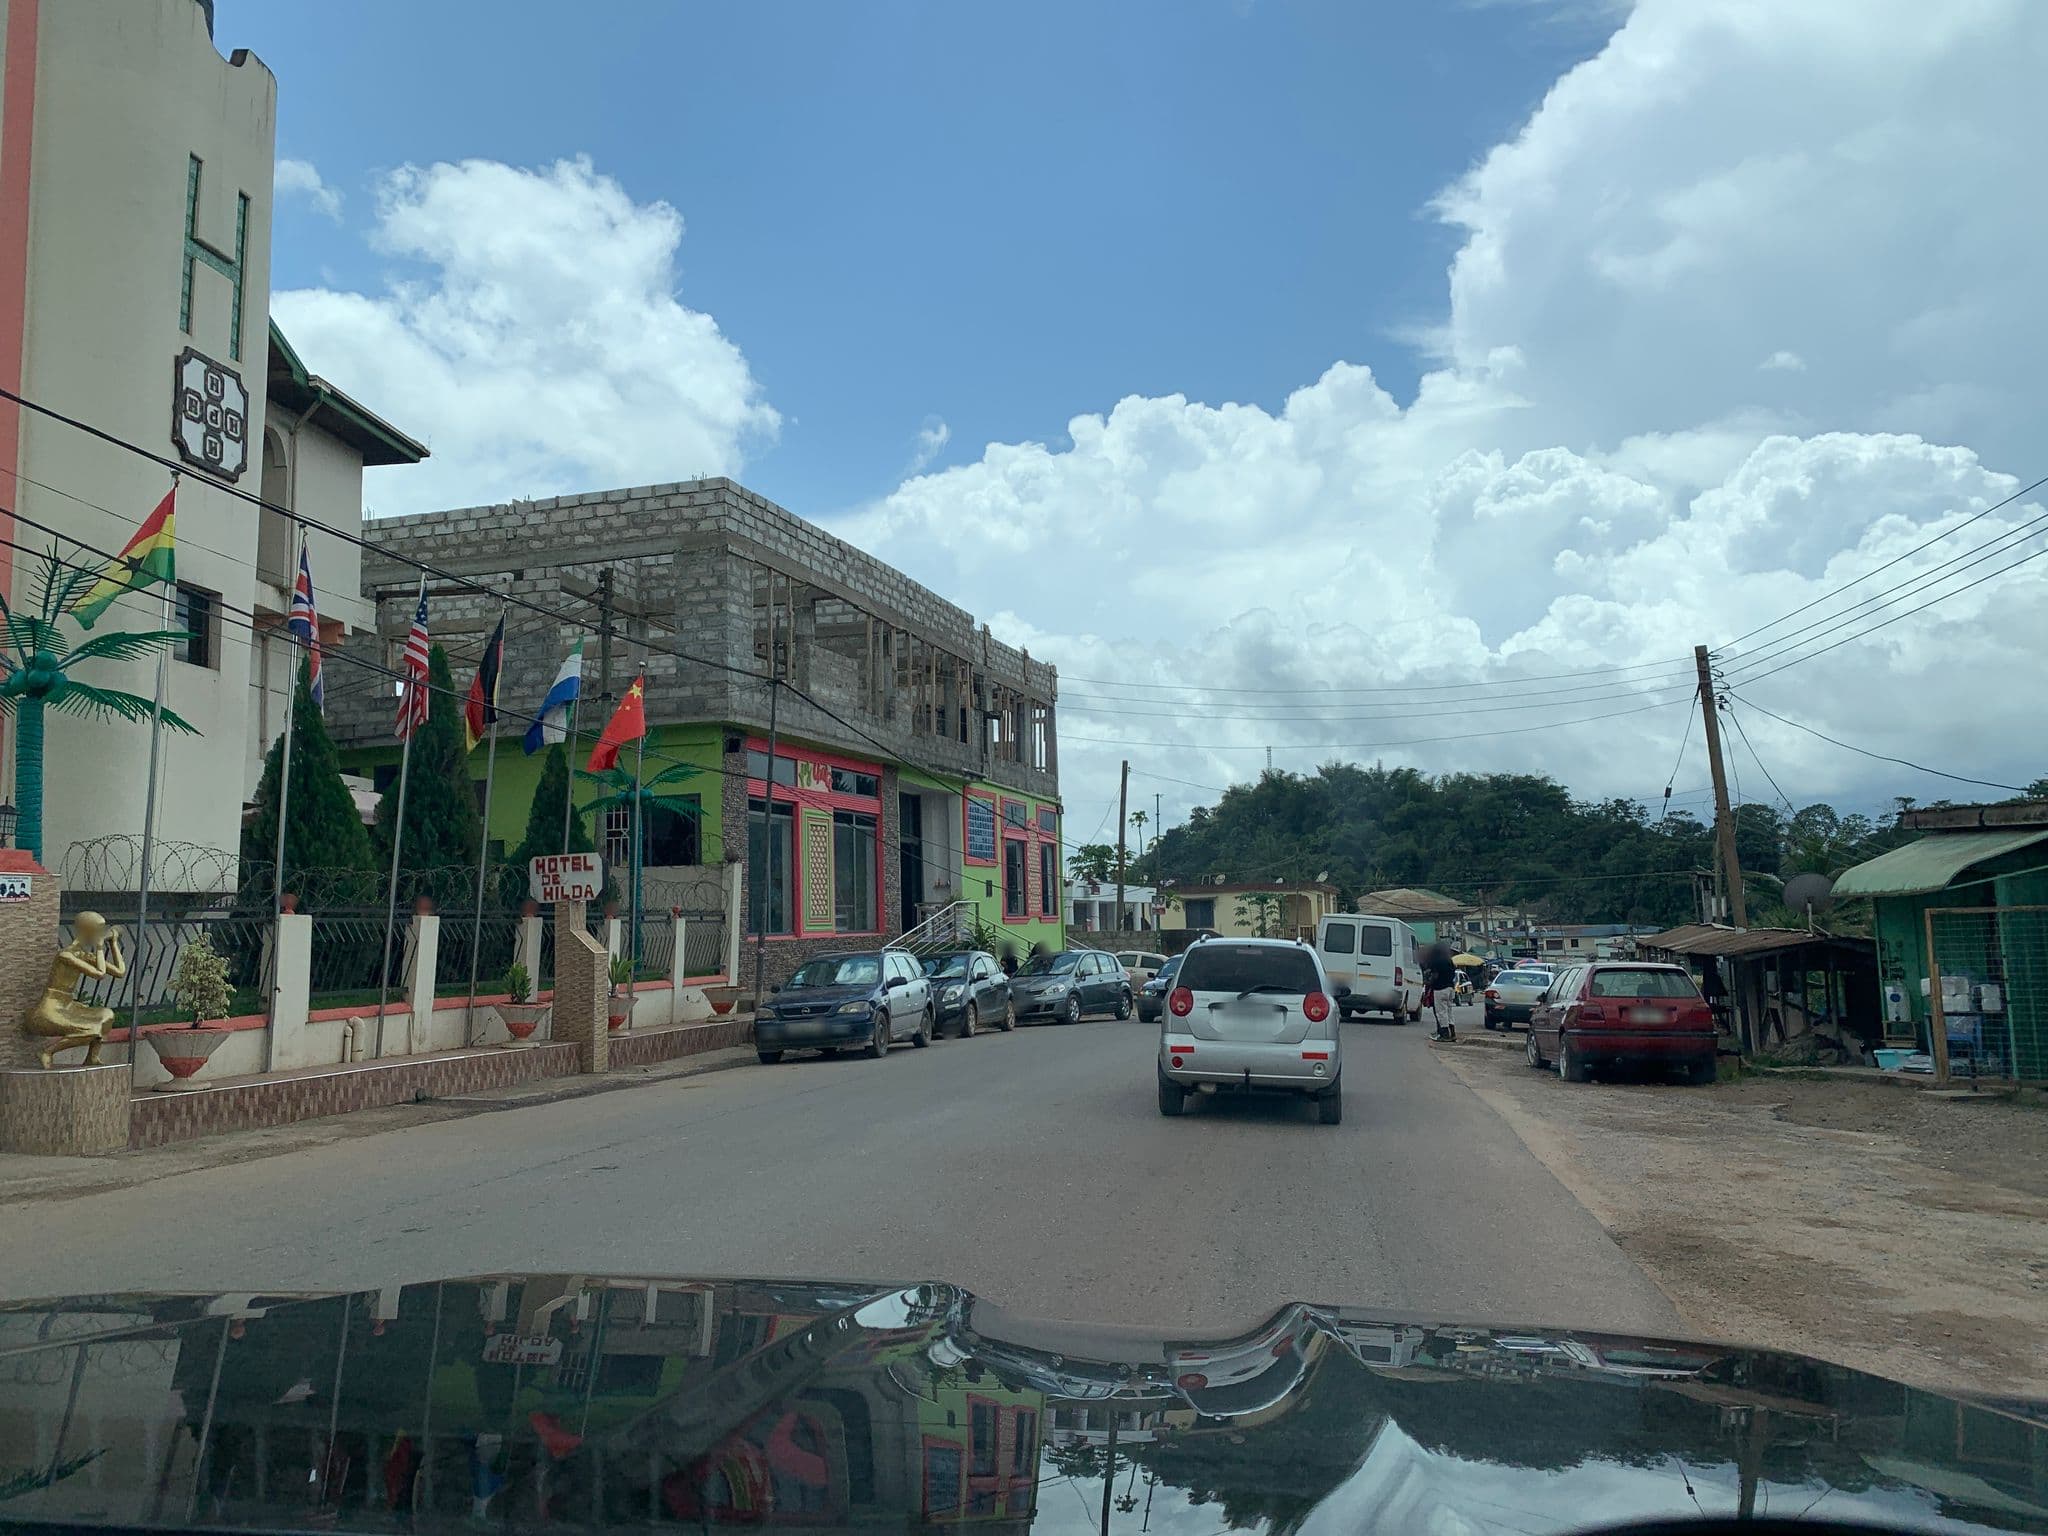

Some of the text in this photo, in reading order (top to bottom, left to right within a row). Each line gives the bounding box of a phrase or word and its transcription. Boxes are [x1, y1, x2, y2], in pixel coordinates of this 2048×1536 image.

[535, 856, 594, 874] HOTEL
[542, 874, 561, 885] DE
[543, 884, 595, 901] HILDA
